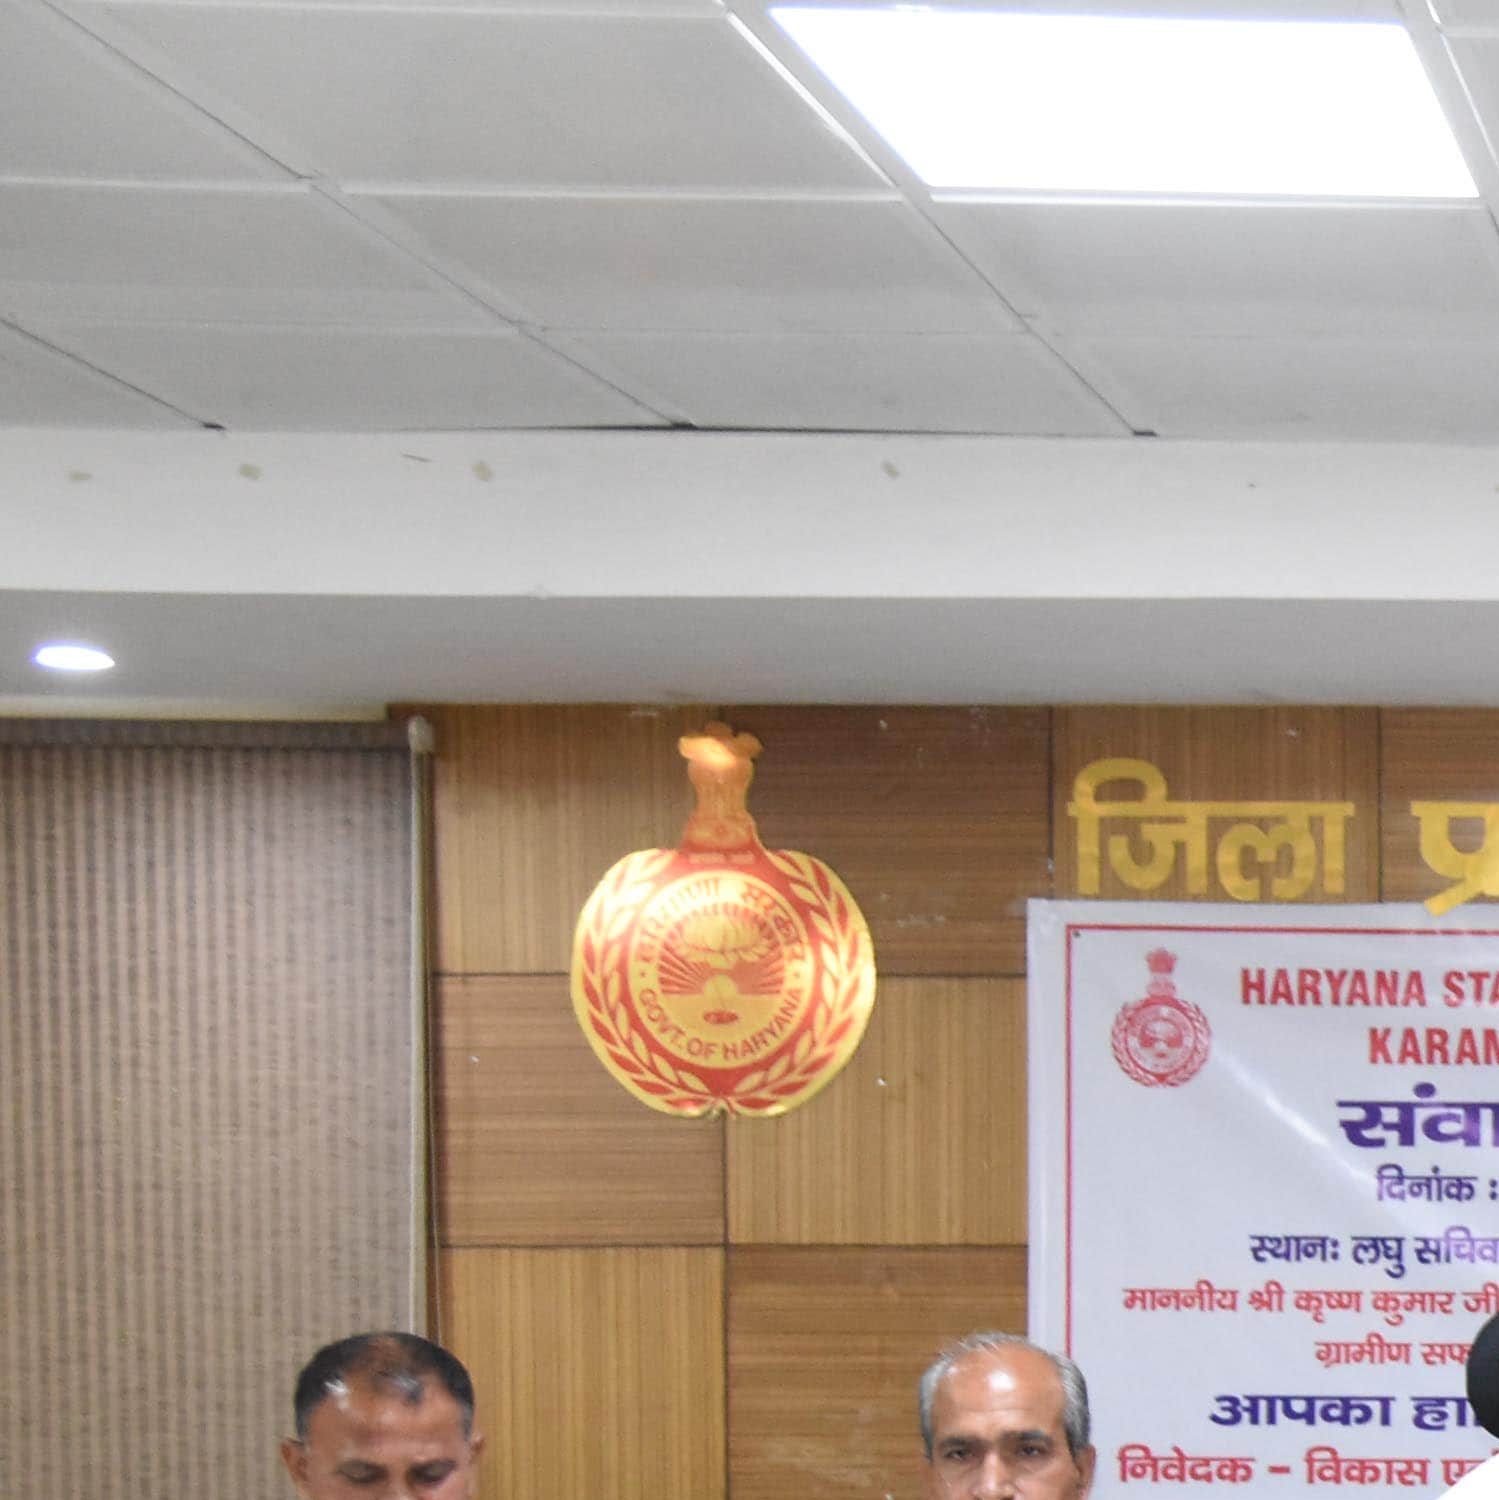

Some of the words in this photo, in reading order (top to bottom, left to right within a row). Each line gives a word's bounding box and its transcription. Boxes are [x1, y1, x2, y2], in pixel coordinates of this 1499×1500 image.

[1066, 757, 1356, 904] जिला
[1240, 967, 1427, 1008] HARYANA
[686, 1036, 718, 1060] OF
[1375, 1162, 1479, 1203] दिनांक
[1350, 1235, 1407, 1280] लघु
[1122, 1278, 1240, 1313] माननीय
[1247, 1279, 1287, 1313] श्री
[1293, 1289, 1363, 1324] कृष्ण
[1370, 1290, 1457, 1328] कुमार
[1314, 1331, 1413, 1369] ग्रामीण
[1207, 1393, 1397, 1428] आपका
[1116, 1442, 1257, 1485] निवेदक
[1303, 1444, 1432, 1488] विकास
